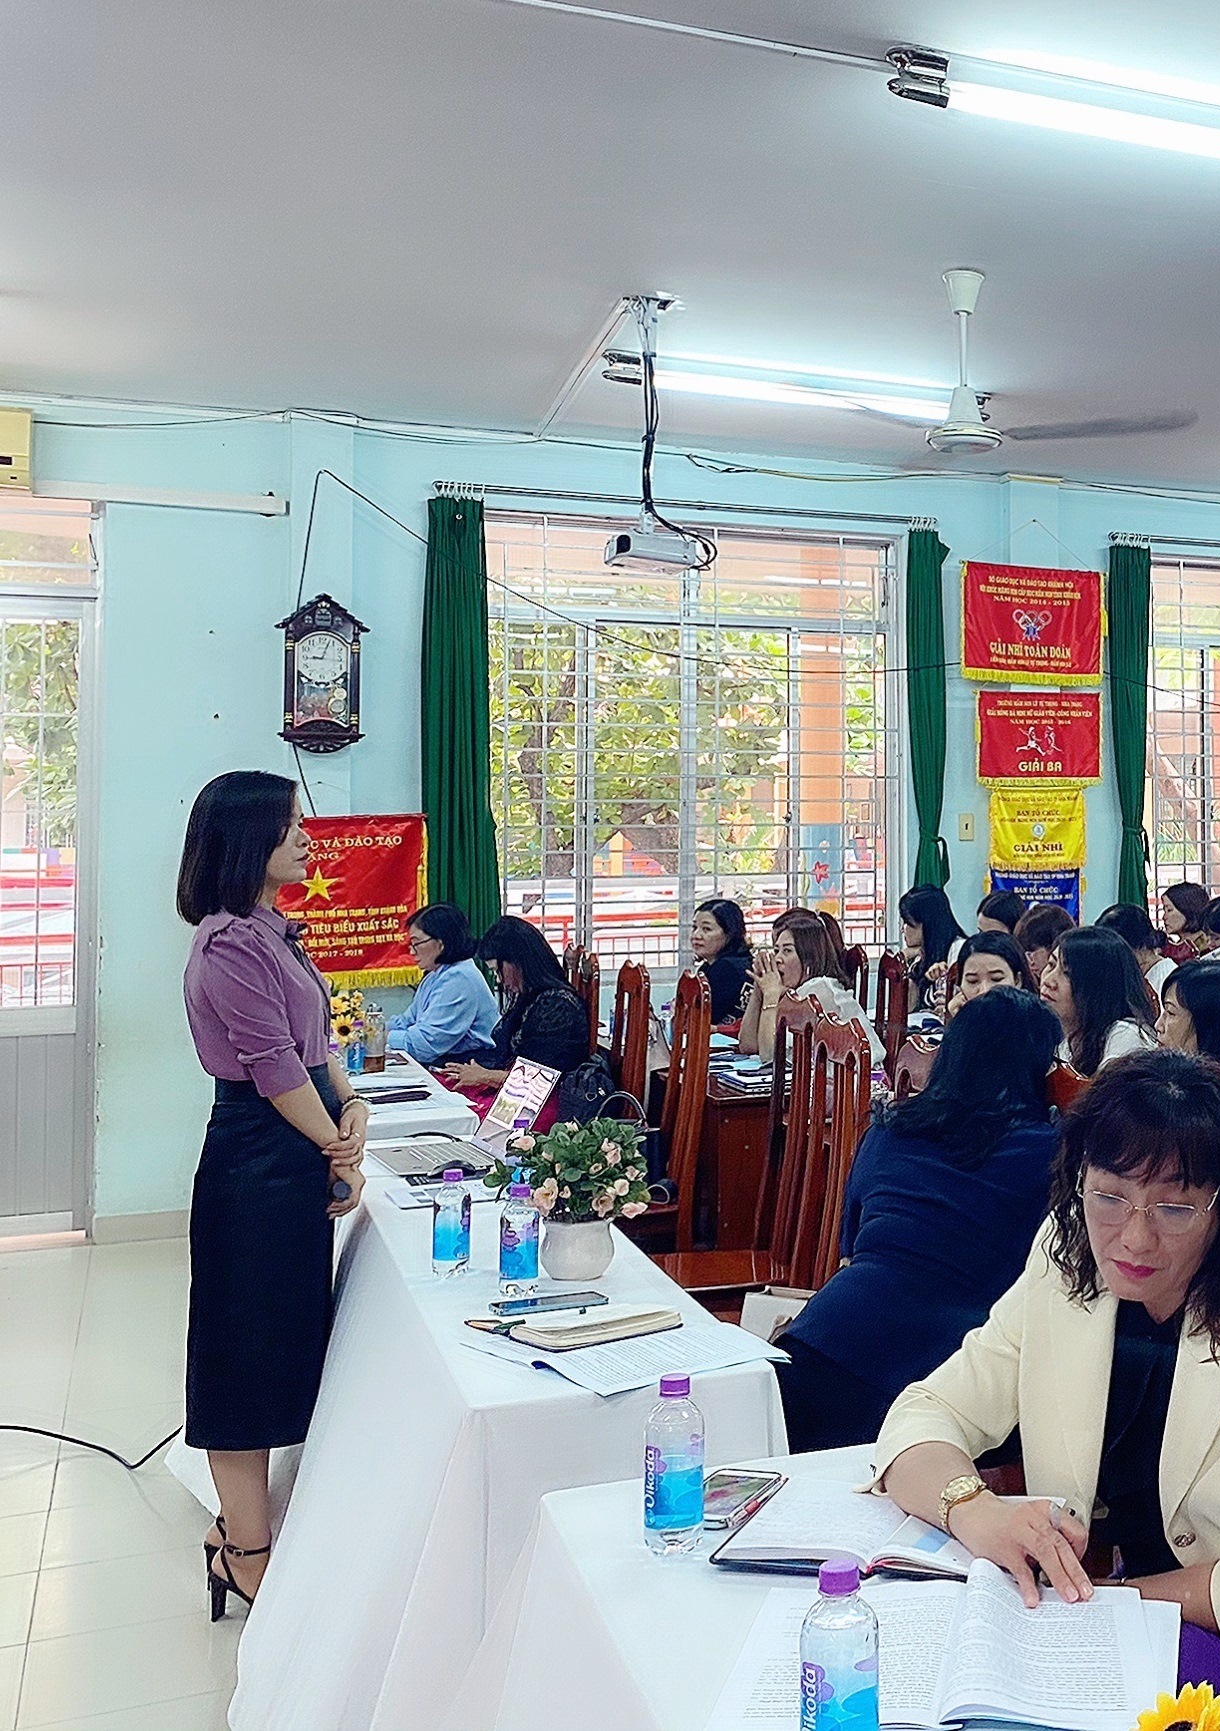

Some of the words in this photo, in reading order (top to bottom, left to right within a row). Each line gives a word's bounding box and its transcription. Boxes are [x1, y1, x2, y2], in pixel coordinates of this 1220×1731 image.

[989, 638, 1006, 655] GIẢI
[1018, 757, 1044, 772] GIẢI
[1047, 761, 1062, 772] BA
[322, 836, 341, 849] VÀ
[345, 835, 373, 847] ĐÀO
[375, 835, 402, 849] TẠO
[1013, 841, 1039, 852] GIẢI
[1013, 886, 1028, 894] BAN
[1029, 884, 1038, 893] TỔ
[310, 922, 331, 935] TIÊU
[333, 919, 355, 933] BIỂU
[357, 918, 380, 931] XUẤT
[381, 917, 399, 930] SẮC
[318, 950, 338, 958] 2017
